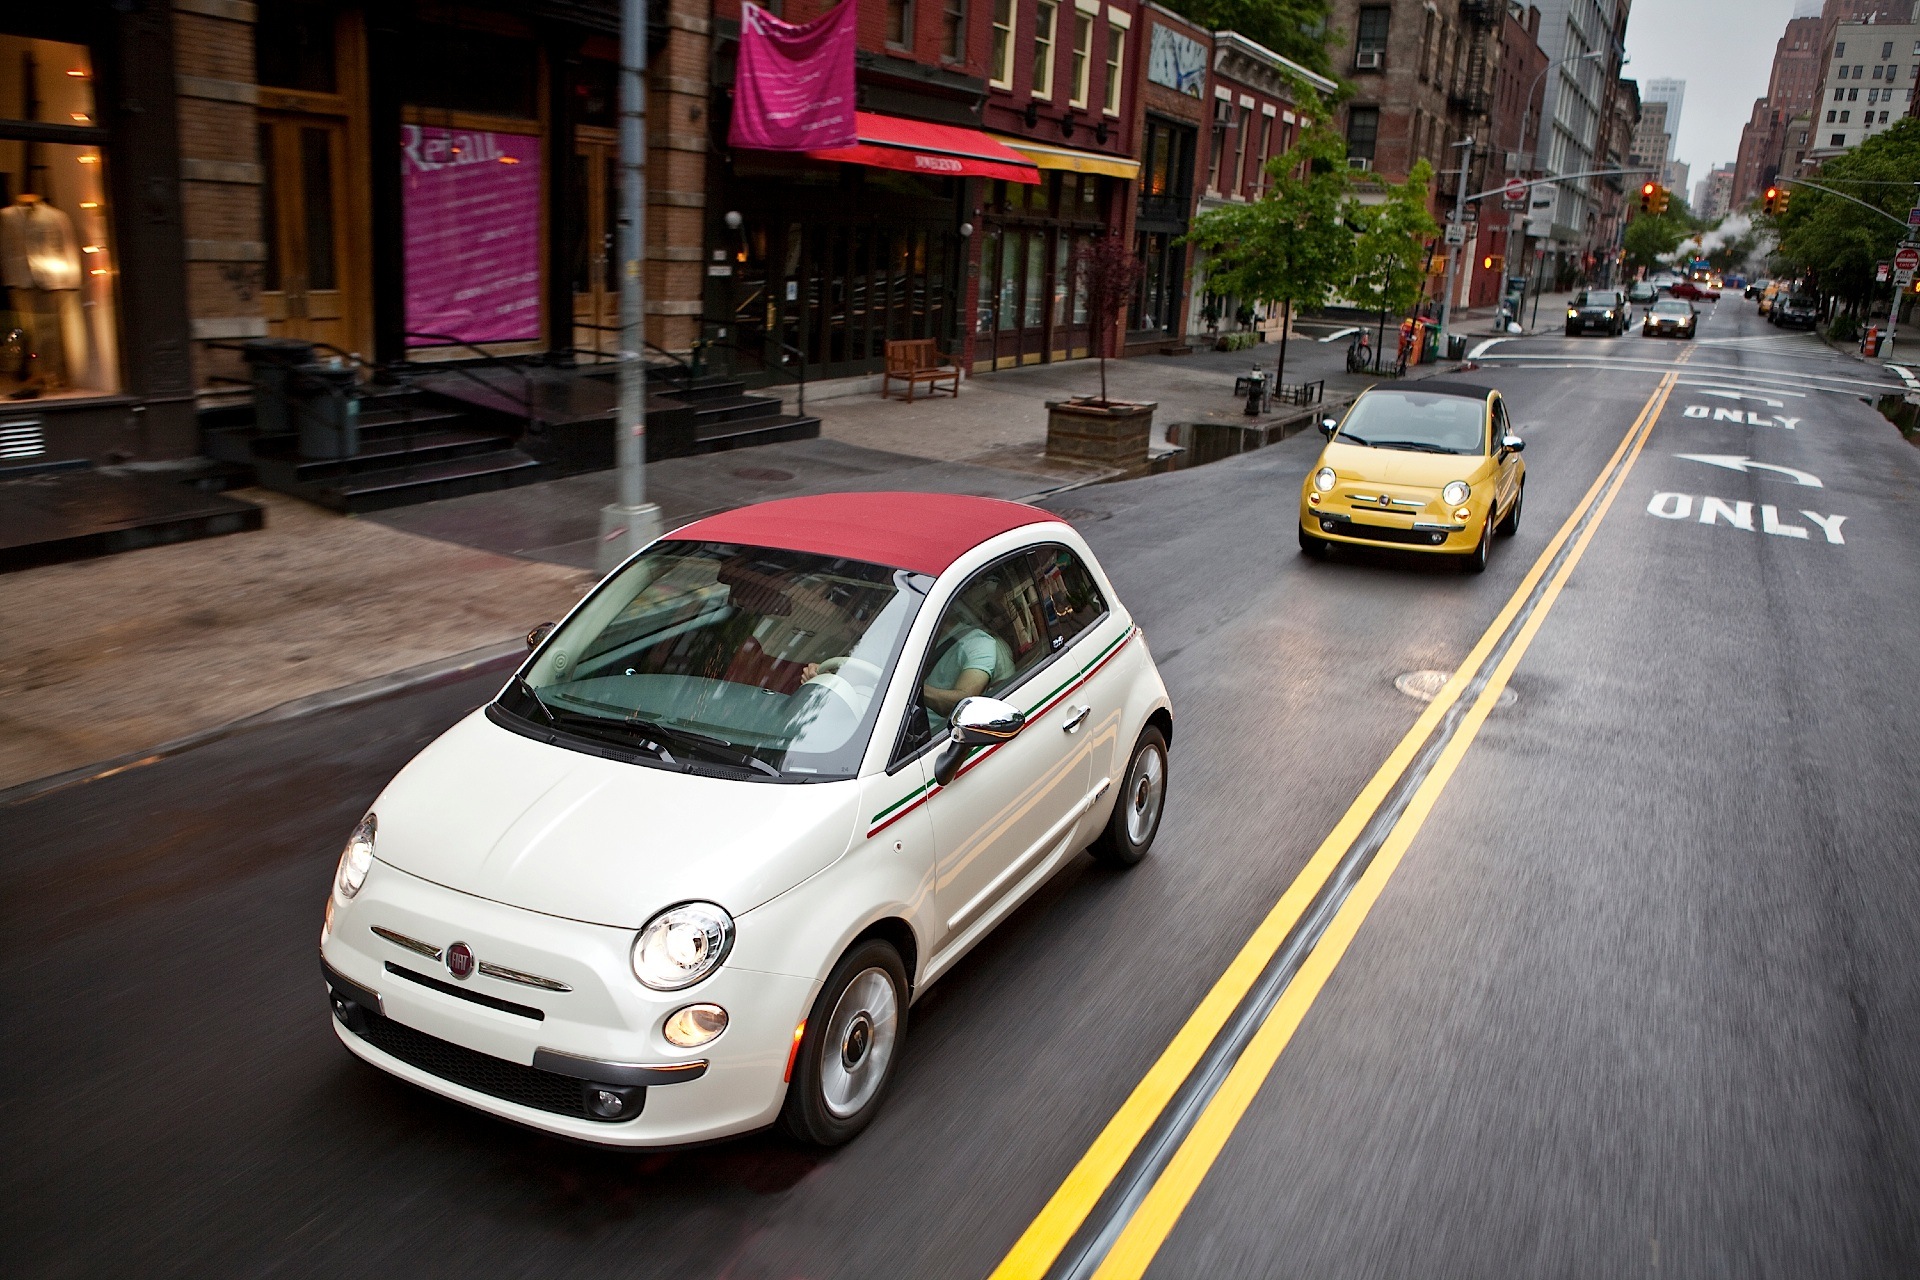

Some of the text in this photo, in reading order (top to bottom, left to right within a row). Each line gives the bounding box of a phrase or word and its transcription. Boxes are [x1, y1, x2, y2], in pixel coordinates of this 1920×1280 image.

[1683, 405, 1800, 430] ONLY
[1647, 492, 1847, 545] ONLY
[452, 952, 468, 971] FIAT
